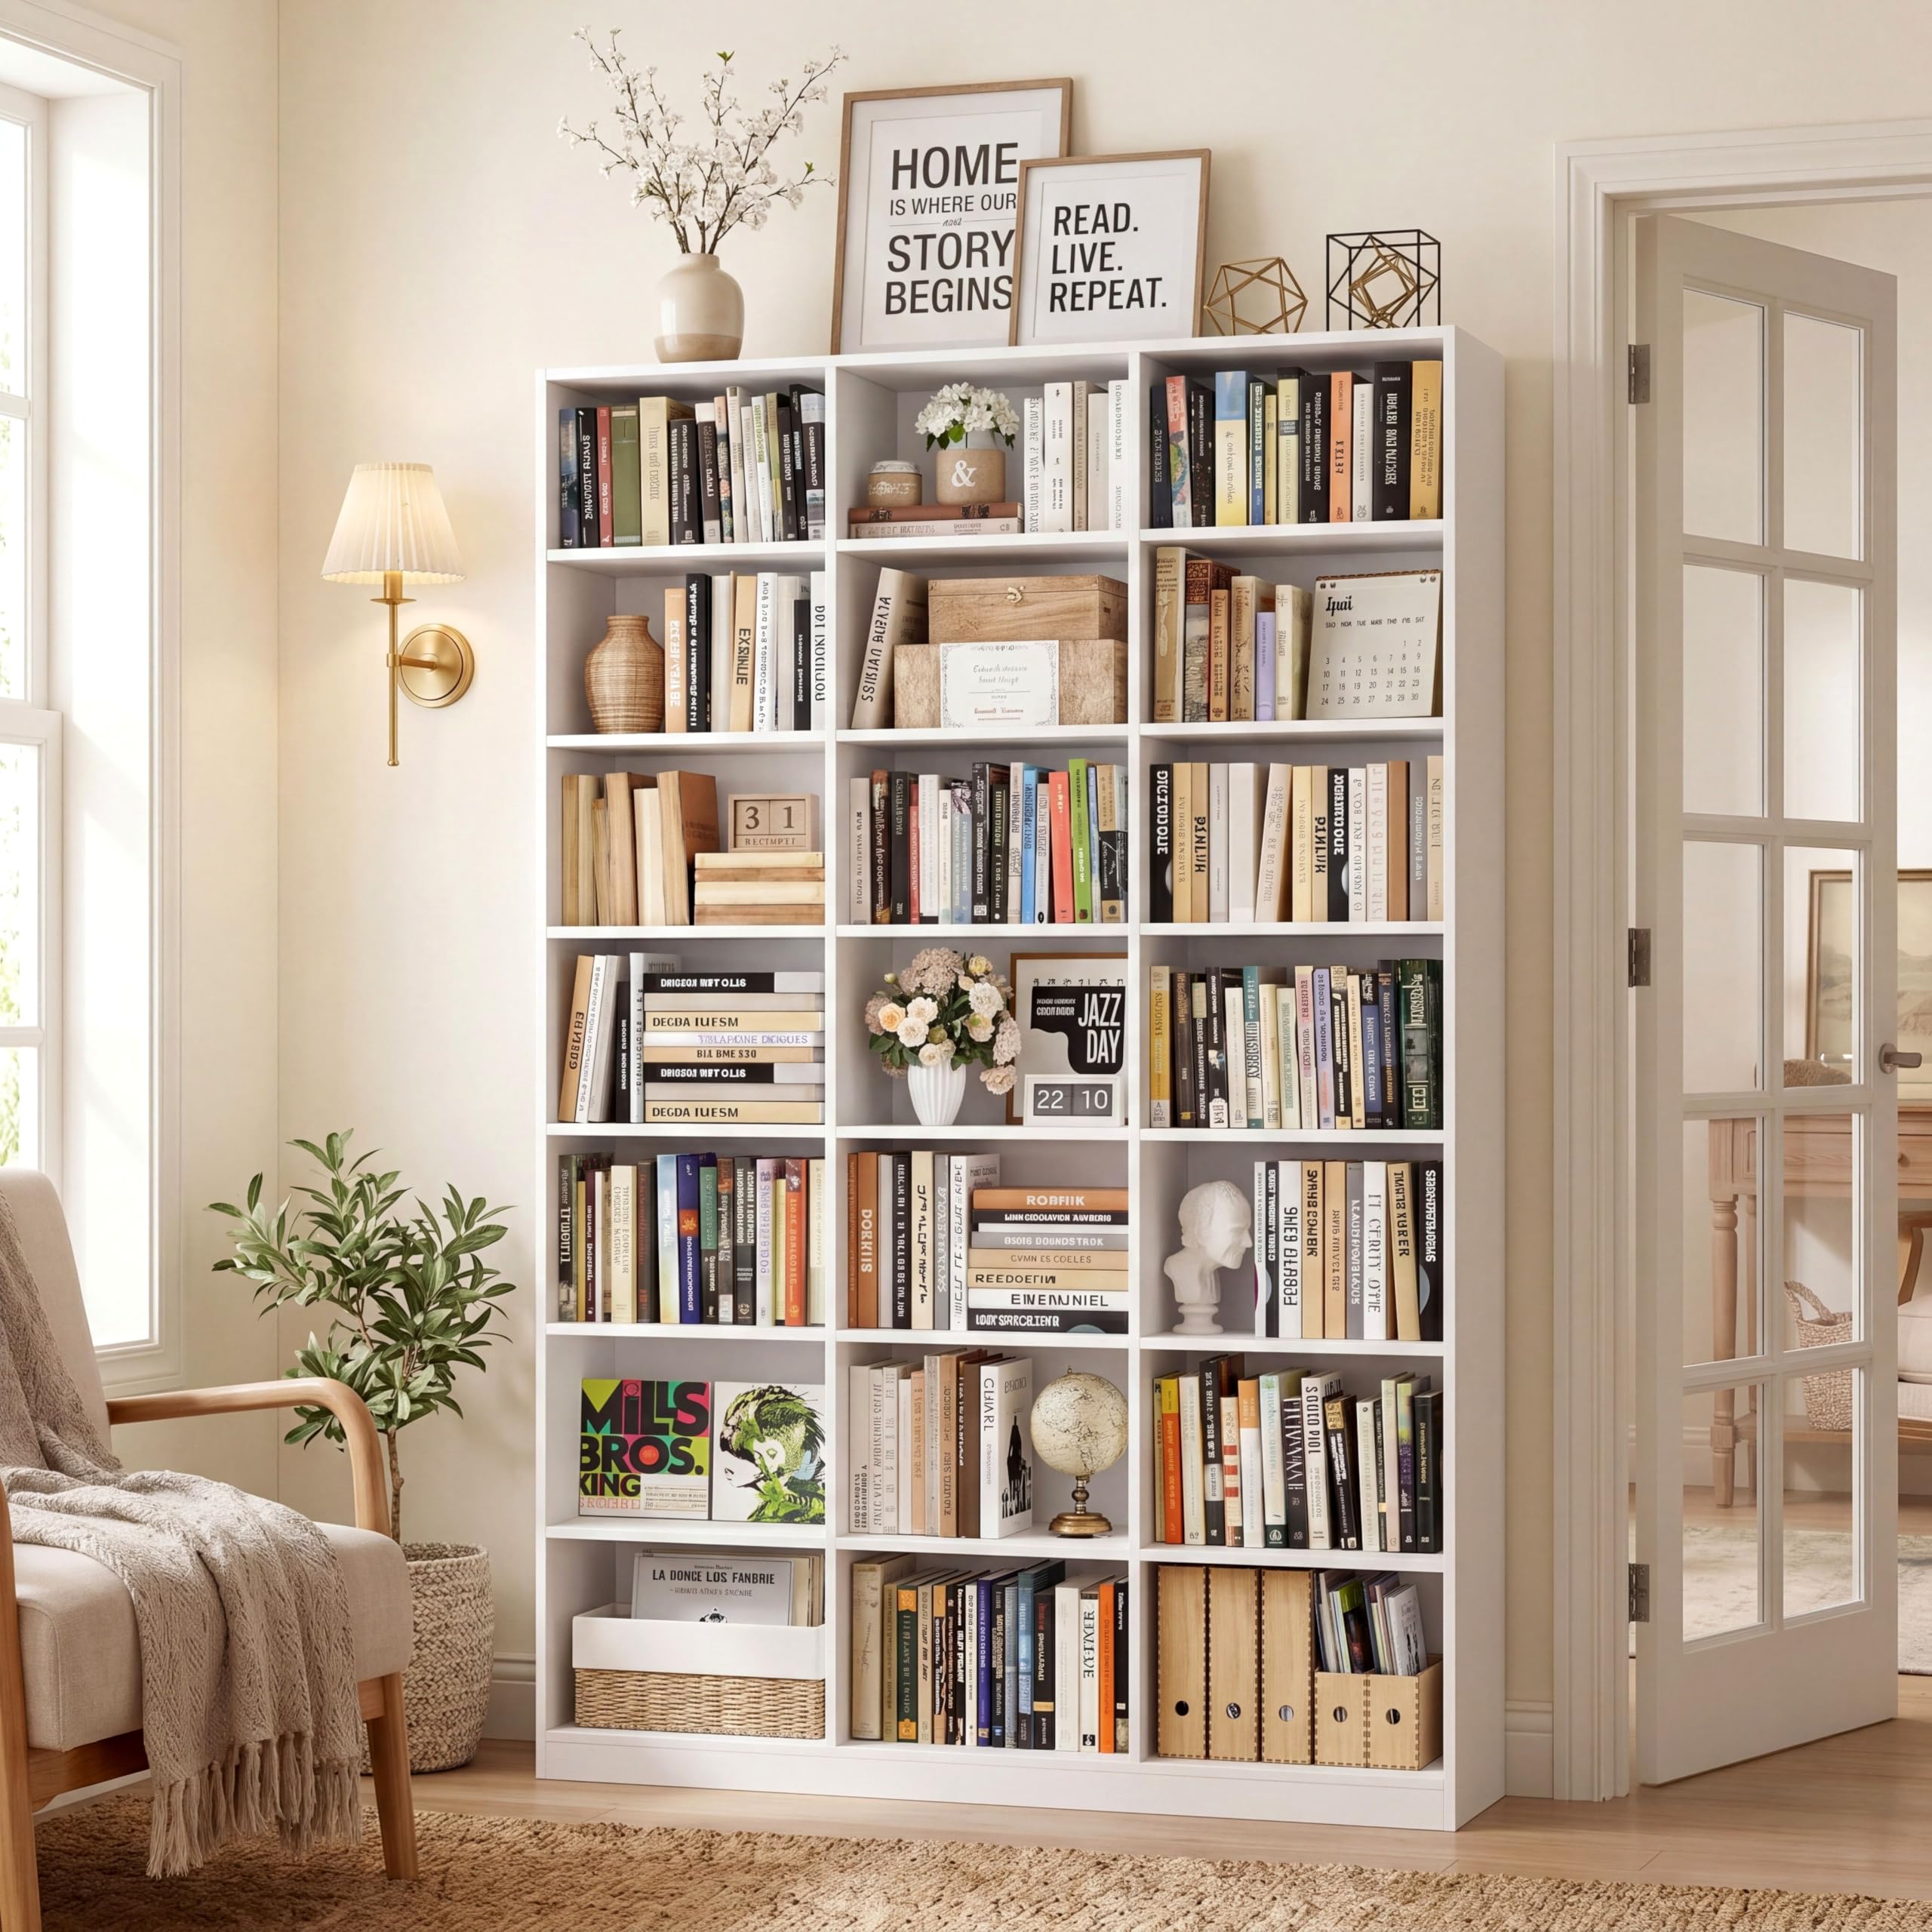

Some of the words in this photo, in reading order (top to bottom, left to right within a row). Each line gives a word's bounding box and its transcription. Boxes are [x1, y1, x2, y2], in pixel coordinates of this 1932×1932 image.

[891, 142, 1019, 190] HOME
[890, 198, 906, 216] IS
[911, 195, 975, 214] WHERE
[980, 192, 1017, 211] OUR
[1054, 202, 1139, 236] READ.
[888, 229, 1016, 272] STORY
[1052, 241, 1123, 275] LIVE.
[884, 275, 1013, 315] BEGINS
[1049, 277, 1167, 313] REPEAT.
[951, 459, 978, 488] &
[1355, 669, 1362, 677] 12
[1400, 666, 1407, 675] 15
[1414, 666, 1420, 674] 16
[1417, 652, 1421, 660] 9
[1368, 681, 1377, 689] 20
[1386, 680, 1392, 688] 21
[1321, 697, 1329, 706] 24
[745, 805, 760, 830] 3
[783, 805, 795, 829] 1
[1078, 992, 1121, 1027] JAZZ
[1086, 1029, 1121, 1063] DAY
[1037, 1089, 1064, 1109] 22
[1081, 1089, 1109, 1109] 10
[580, 1435, 704, 1475] BROS.
[652, 1569, 666, 1581] LA
[669, 1570, 703, 1582] DONCE
[706, 1571, 728, 1583] LOS
[732, 1572, 775, 1585] FANBRIE
